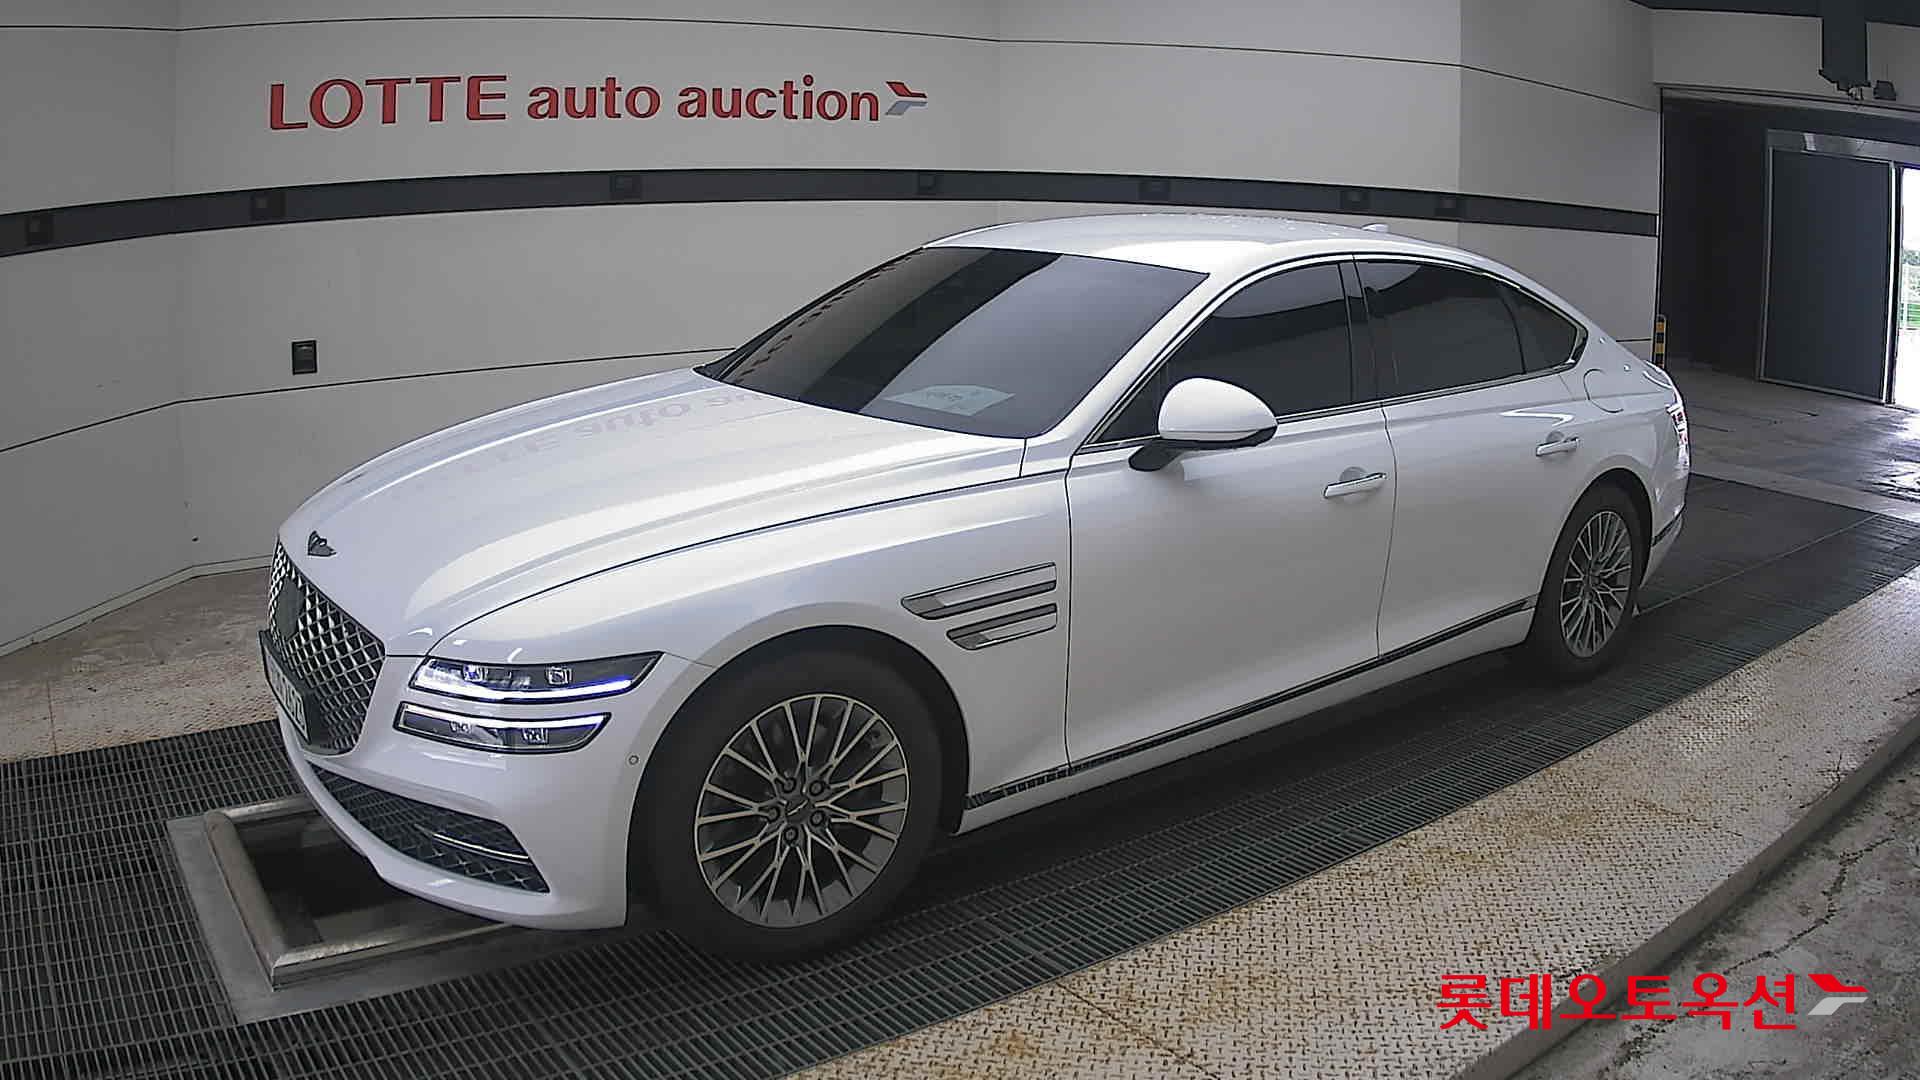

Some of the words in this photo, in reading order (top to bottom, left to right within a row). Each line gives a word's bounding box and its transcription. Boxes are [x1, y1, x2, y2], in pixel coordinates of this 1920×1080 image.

[270, 75, 507, 130] LOTTE
[527, 77, 661, 120] auto
[677, 74, 880, 121] auction
